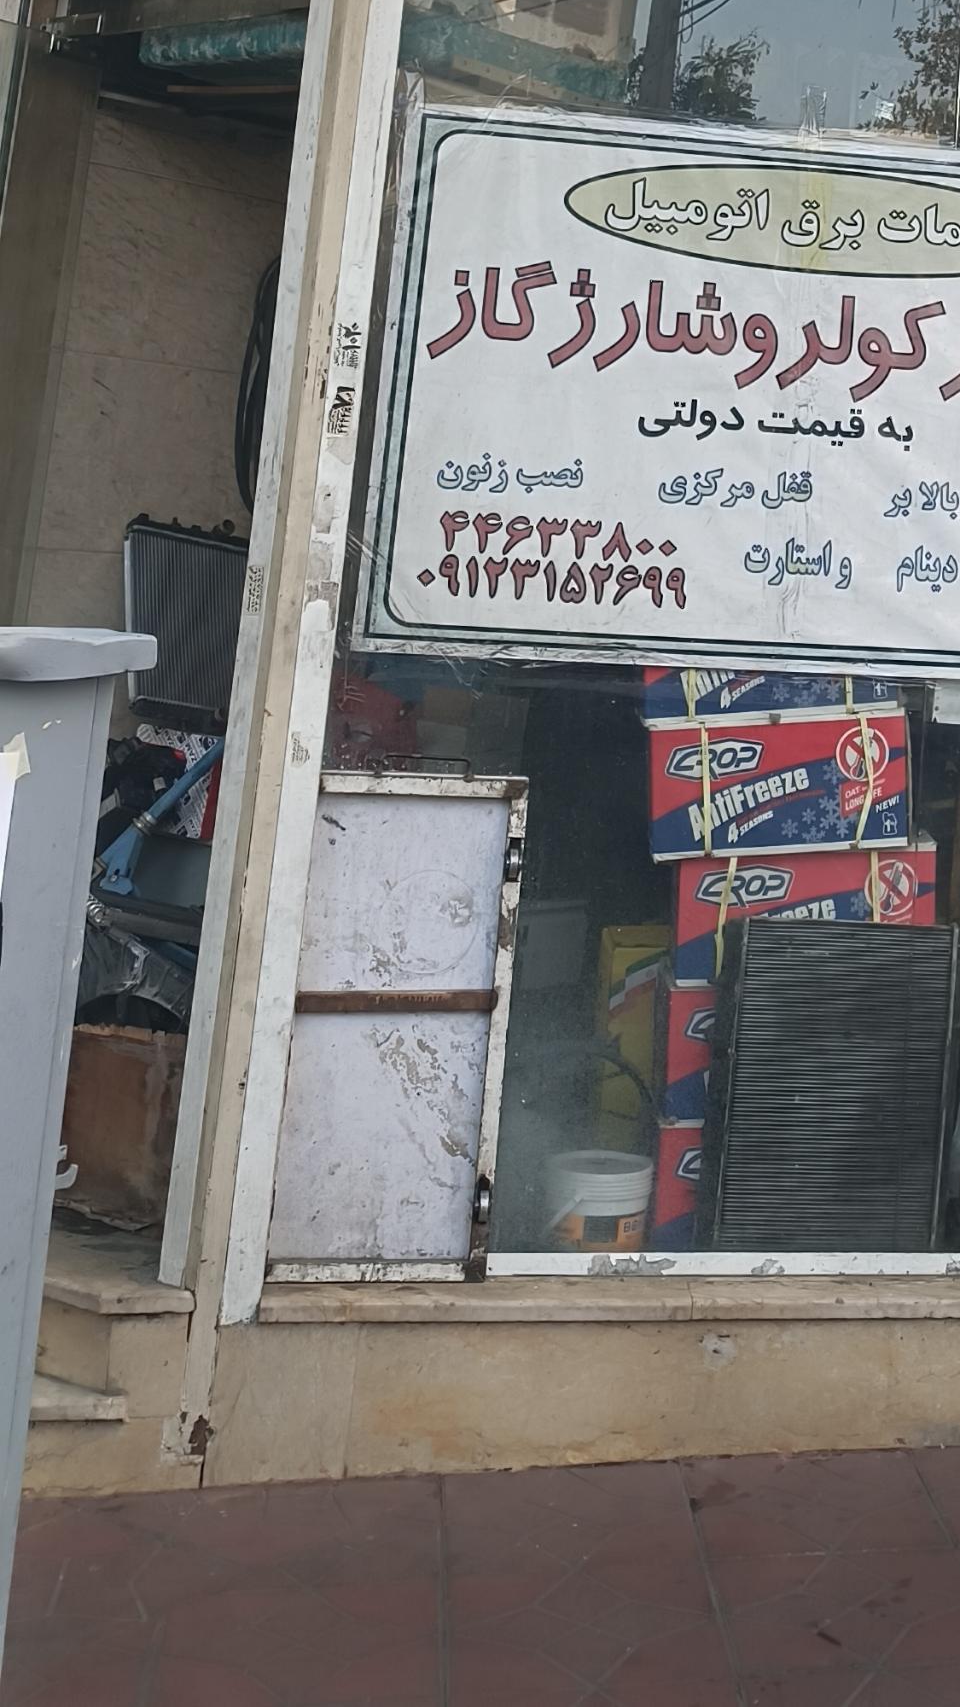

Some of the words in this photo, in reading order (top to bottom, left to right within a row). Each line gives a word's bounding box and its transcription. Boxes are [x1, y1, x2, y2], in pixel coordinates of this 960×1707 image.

[603, 177, 771, 242] اتومبیل
[780, 198, 865, 251] برق
[425, 260, 558, 361] گاز
[775, 295, 946, 404] کولر
[637, 398, 745, 441] دولتی
[757, 408, 865, 447] قیمت
[876, 415, 914, 452] به
[436, 452, 510, 494] زنون
[516, 458, 584, 494] نصب
[657, 467, 755, 508] مرکزی
[761, 470, 813, 510] قفل
[439, 509, 678, 564] ۴۴۶۳۳۸۰۰
[416, 553, 687, 610] ۰۹۱۲۳۱۵۲۶۹۹
[743, 537, 832, 586] استارت
[896, 545, 959, 594] دینام
[672, 746, 758, 781] CROP
[687, 767, 811, 843] AntiFreeze
[738, 810, 774, 837] SEASONS
[845, 794, 865, 812] LONG
[875, 794, 900, 814] NEW!
[700, 871, 791, 907] CROP
